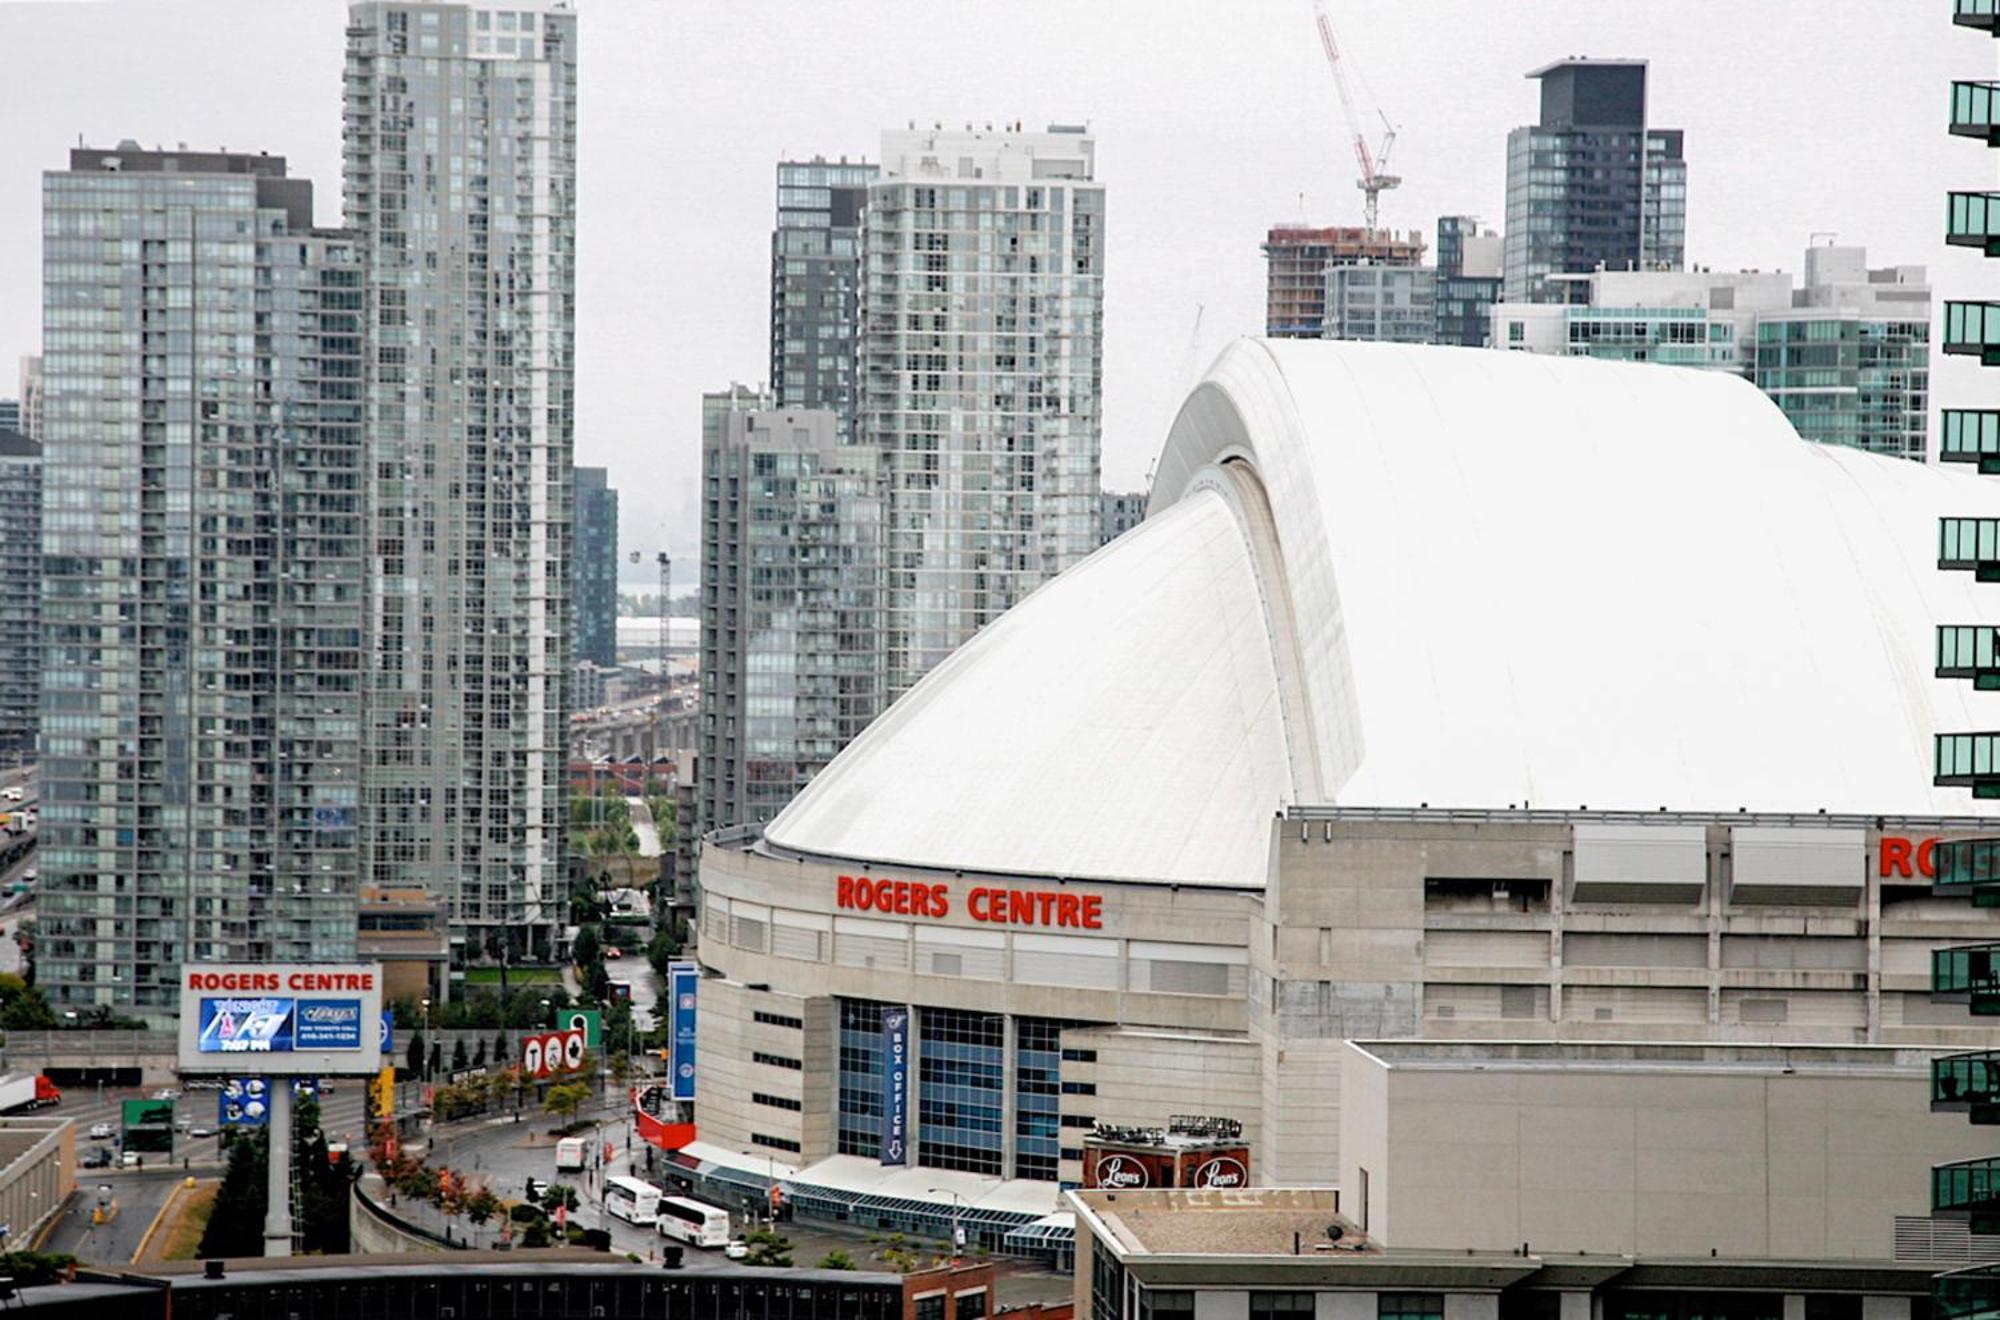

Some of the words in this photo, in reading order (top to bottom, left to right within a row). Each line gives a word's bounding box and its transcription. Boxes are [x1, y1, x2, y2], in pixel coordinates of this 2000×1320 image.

[837, 875, 949, 918] ROGERS
[967, 887, 1103, 930] CENTRE
[189, 973, 280, 991] ROGERS
[287, 973, 374, 991] CENTRE
[893, 1033, 902, 1065] BOX
[893, 1072, 902, 1136] OFFICE
[1102, 1158, 1141, 1188] Leon's
[1202, 1160, 1239, 1188] Leon's
